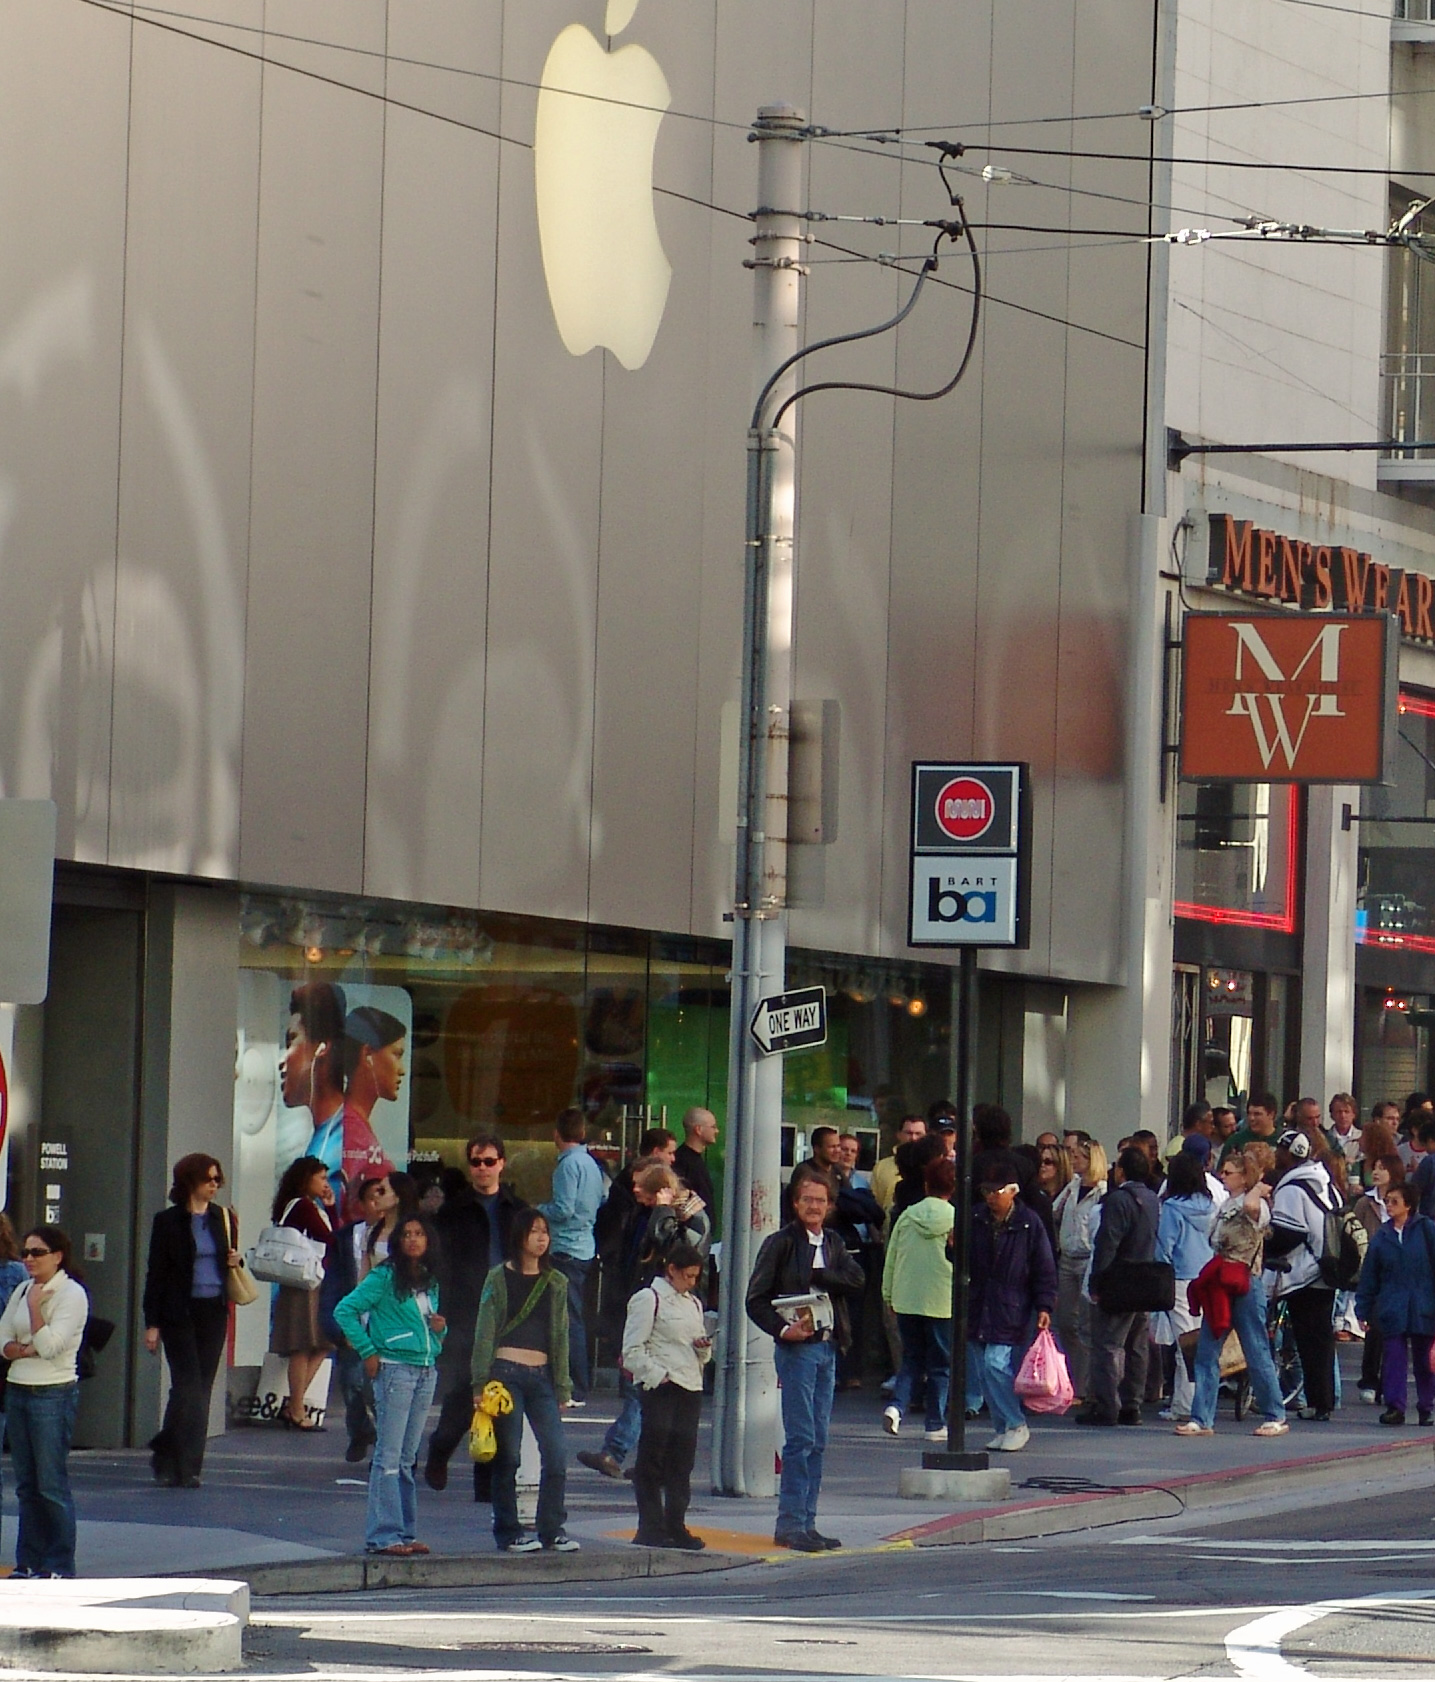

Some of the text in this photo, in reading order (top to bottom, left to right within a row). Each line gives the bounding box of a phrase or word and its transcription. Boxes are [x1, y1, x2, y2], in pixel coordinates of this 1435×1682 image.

[1222, 514, 1333, 608] MEN'S
[948, 877, 997, 886] BART
[768, 1005, 816, 1034] ONE WAY
[41, 1142, 67, 1155] POWELL
[40, 1157, 68, 1170] STATION
